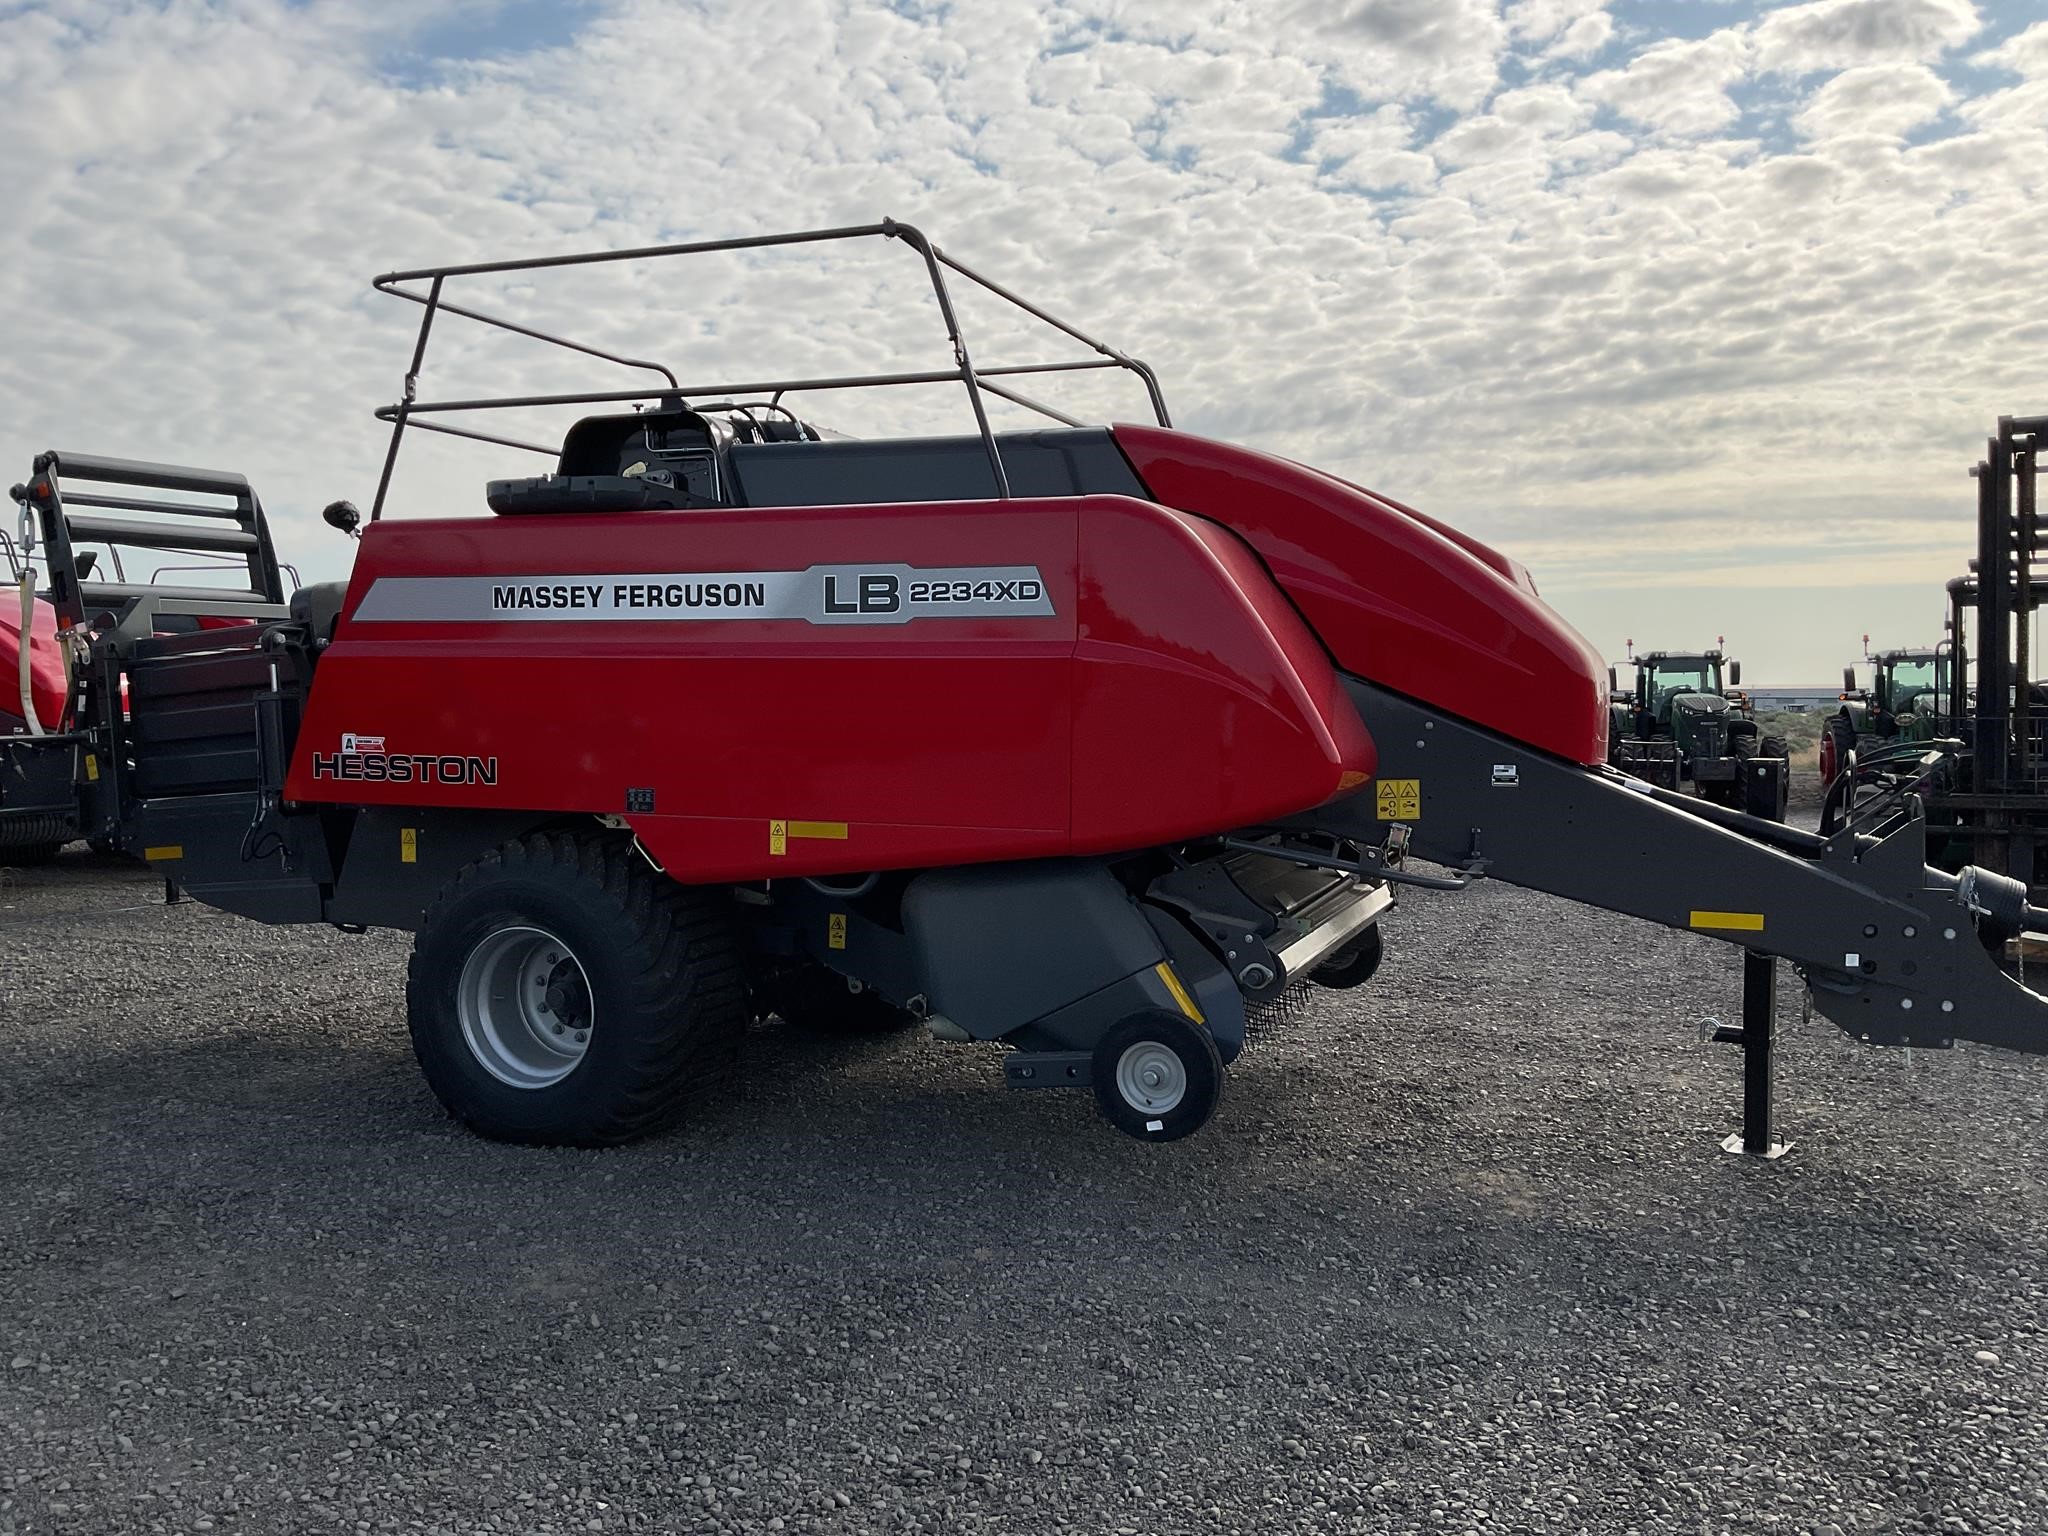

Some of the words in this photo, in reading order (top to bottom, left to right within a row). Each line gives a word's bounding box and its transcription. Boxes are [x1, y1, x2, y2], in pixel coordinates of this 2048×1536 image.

[492, 584, 604, 609] MASSEY
[613, 583, 765, 608] FERGUSON
[823, 574, 900, 615] LB
[908, 579, 1042, 603] 2234XD
[312, 752, 498, 786] HESSTON
